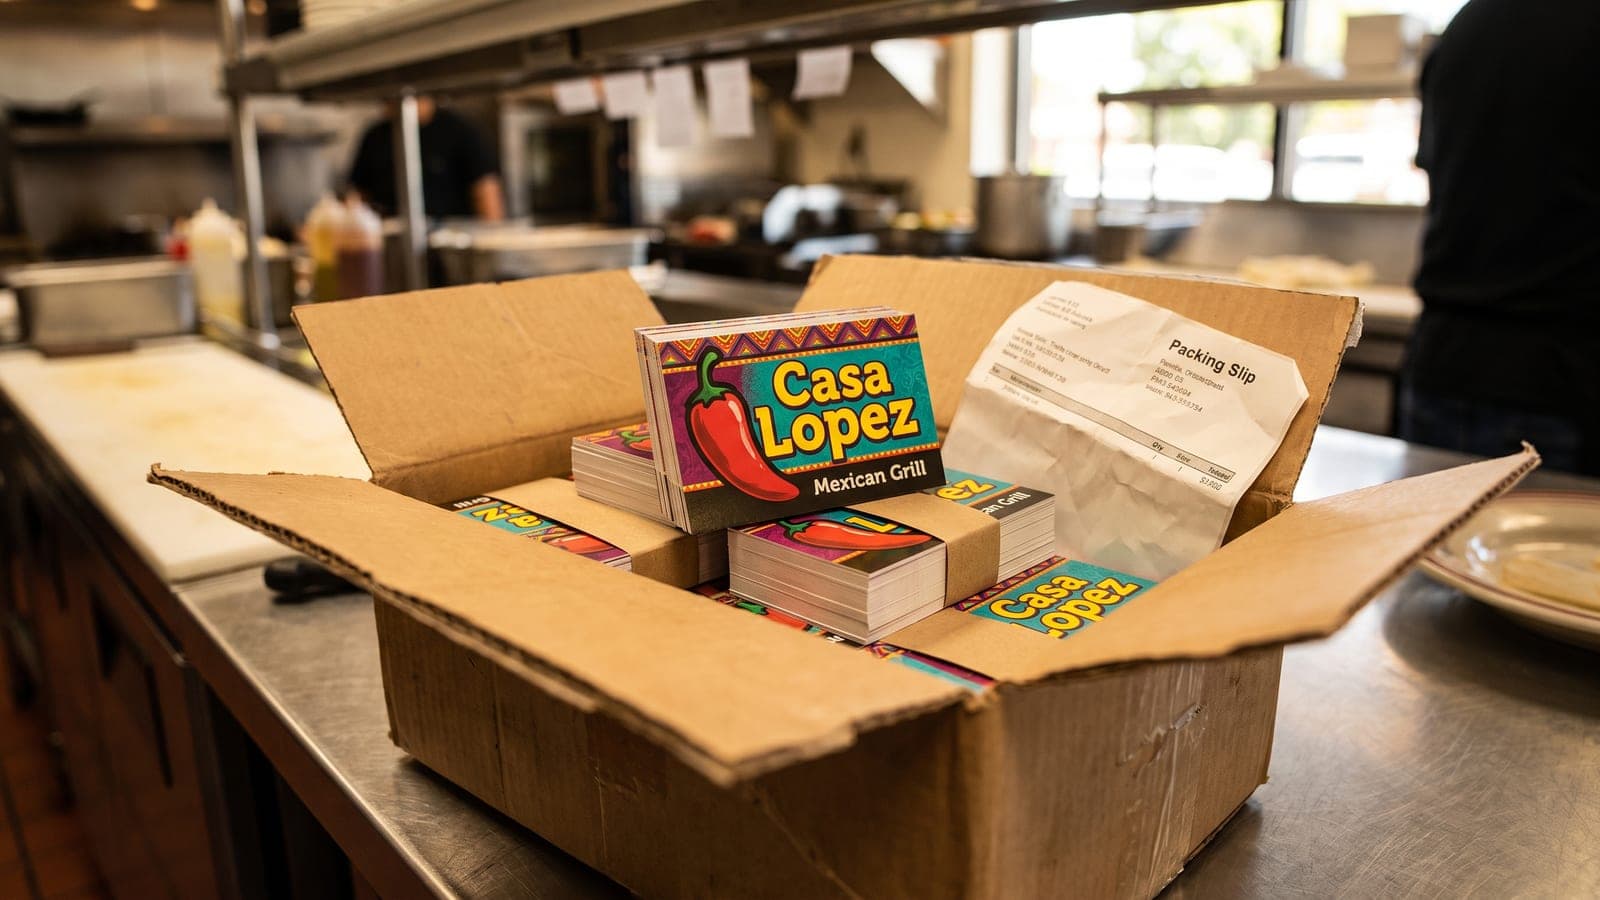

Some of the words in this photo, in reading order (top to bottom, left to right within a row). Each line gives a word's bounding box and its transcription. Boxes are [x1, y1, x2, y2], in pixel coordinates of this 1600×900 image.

[773, 360, 892, 407] Casa
[1168, 339, 1225, 374] Packing
[1228, 363, 1256, 385] Slip
[755, 396, 919, 462] Lopez
[814, 471, 887, 496] Mexican
[889, 460, 928, 485] Grill
[998, 491, 1032, 506] Grill
[989, 575, 1090, 619] Casa
[1020, 577, 1139, 639] opez
